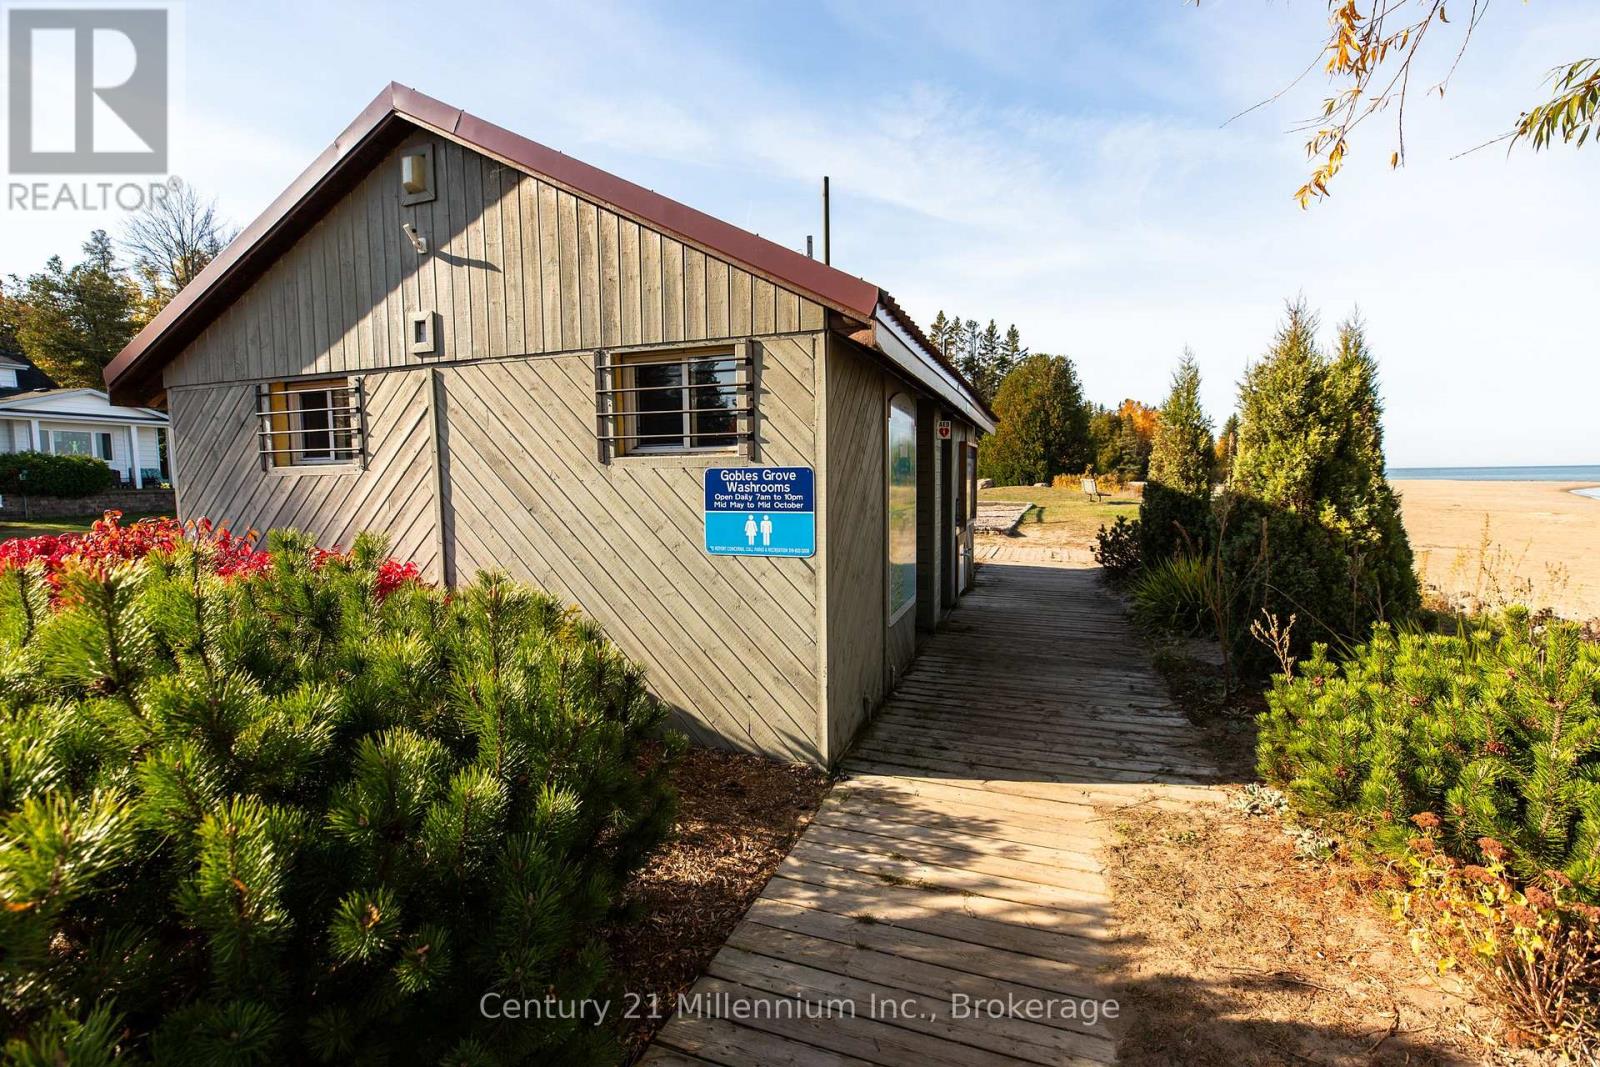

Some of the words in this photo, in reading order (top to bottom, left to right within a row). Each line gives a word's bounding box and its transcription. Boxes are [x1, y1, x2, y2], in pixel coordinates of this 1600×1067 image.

[720, 470, 758, 481] Gobles
[762, 470, 797, 481] Grove
[726, 482, 791, 492] Washrooms
